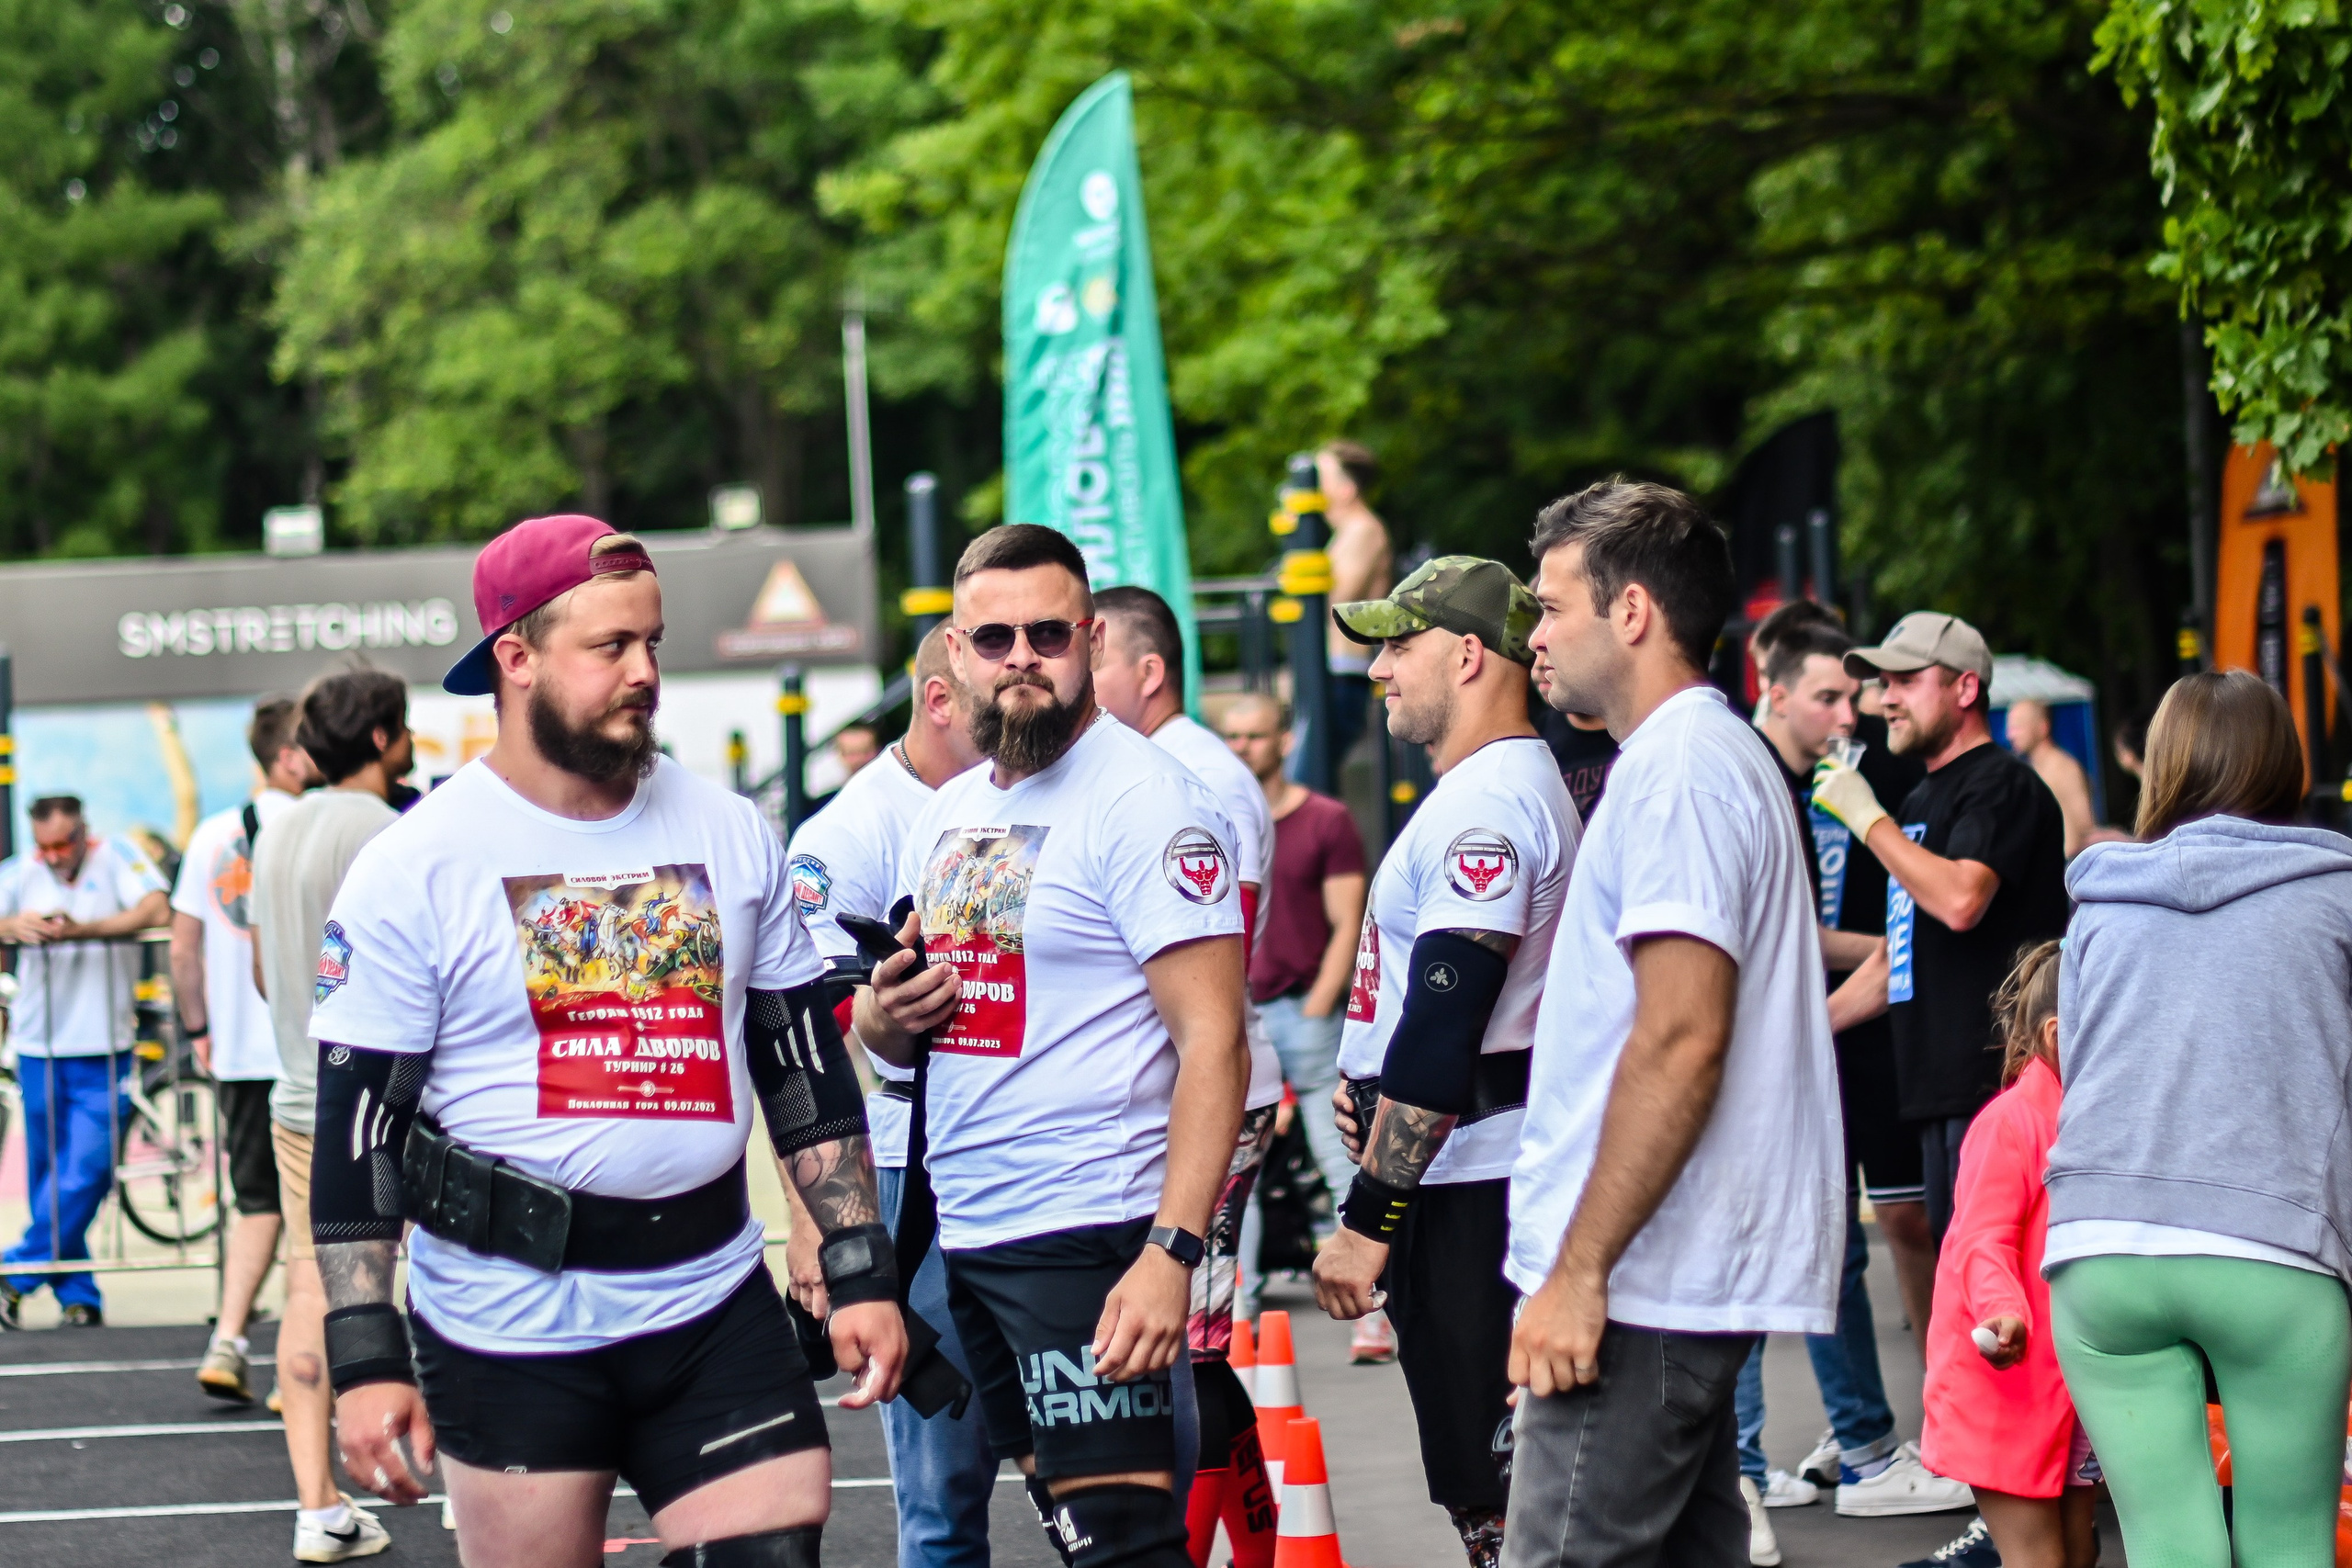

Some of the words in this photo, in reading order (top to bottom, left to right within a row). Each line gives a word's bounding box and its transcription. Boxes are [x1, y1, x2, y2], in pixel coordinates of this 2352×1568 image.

[118, 597, 458, 659] SMSTRETCHING
[570, 874, 607, 884] СИЛОВОЙ
[610, 871, 650, 882] ЭКСТРИМ
[668, 1008, 704, 1019] ГОДА
[552, 1037, 621, 1057] СИЛА
[634, 1037, 721, 1061] ДВОРОВ
[958, 1037, 1001, 1048] 09.07.2023
[605, 1061, 657, 1074] ТУРНИР
[670, 1063, 685, 1075] 26
[664, 1100, 716, 1112] 09.07.2023
[1027, 1385, 1174, 1427] ARMOU
